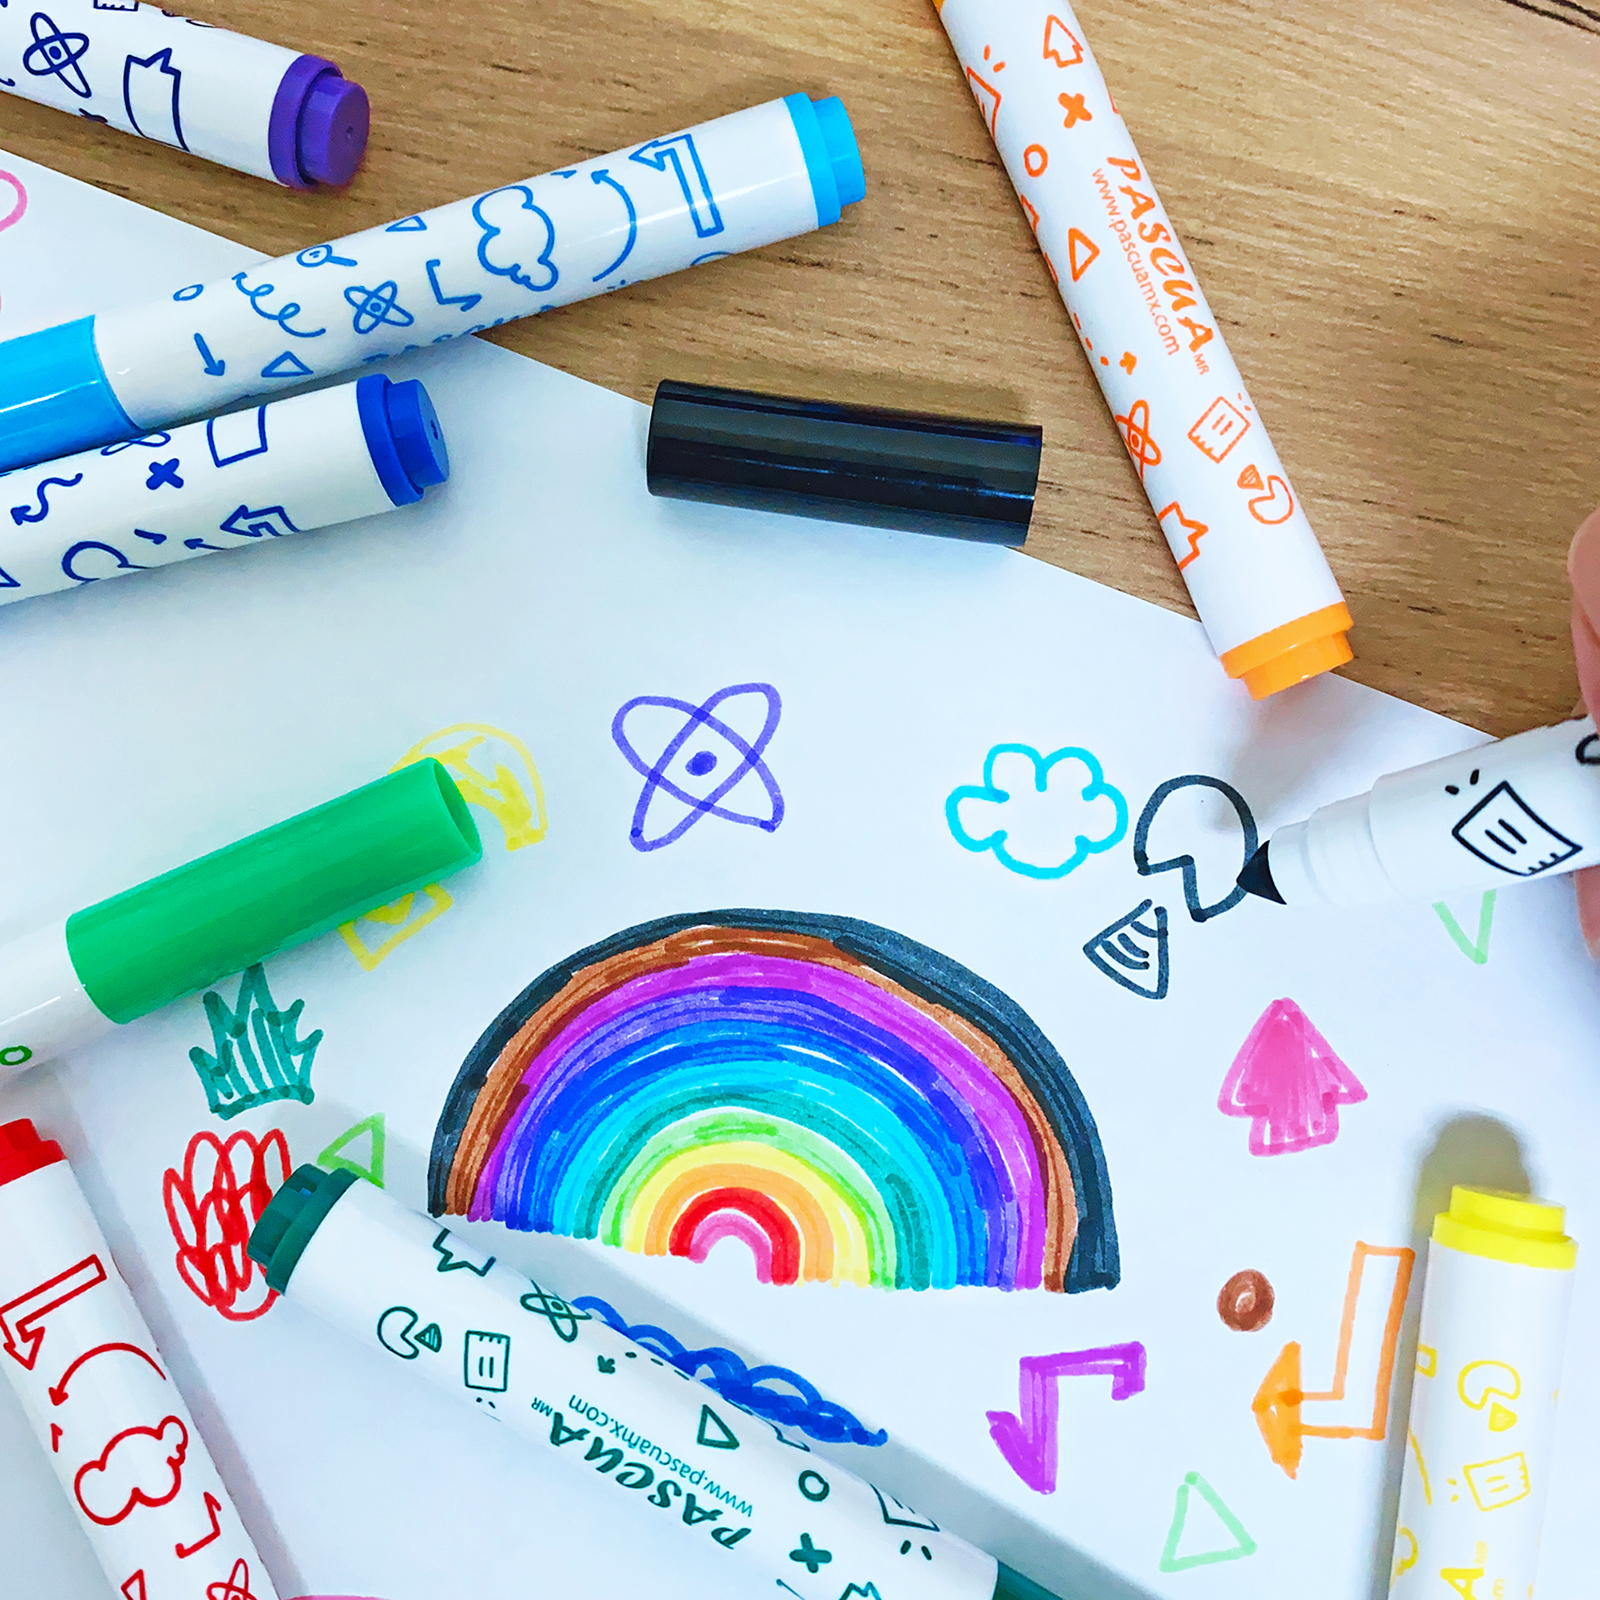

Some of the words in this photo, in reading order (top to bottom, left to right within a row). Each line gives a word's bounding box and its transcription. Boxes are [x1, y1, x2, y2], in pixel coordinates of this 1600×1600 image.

[1091, 167, 1180, 356] www.pascuamx.com
[1106, 156, 1214, 353] PASCUA
[1192, 352, 1210, 376] MR
[530, 1396, 553, 1418] MR
[568, 1394, 753, 1518] www.pascuamx.com
[549, 1411, 752, 1550] PASCUA
